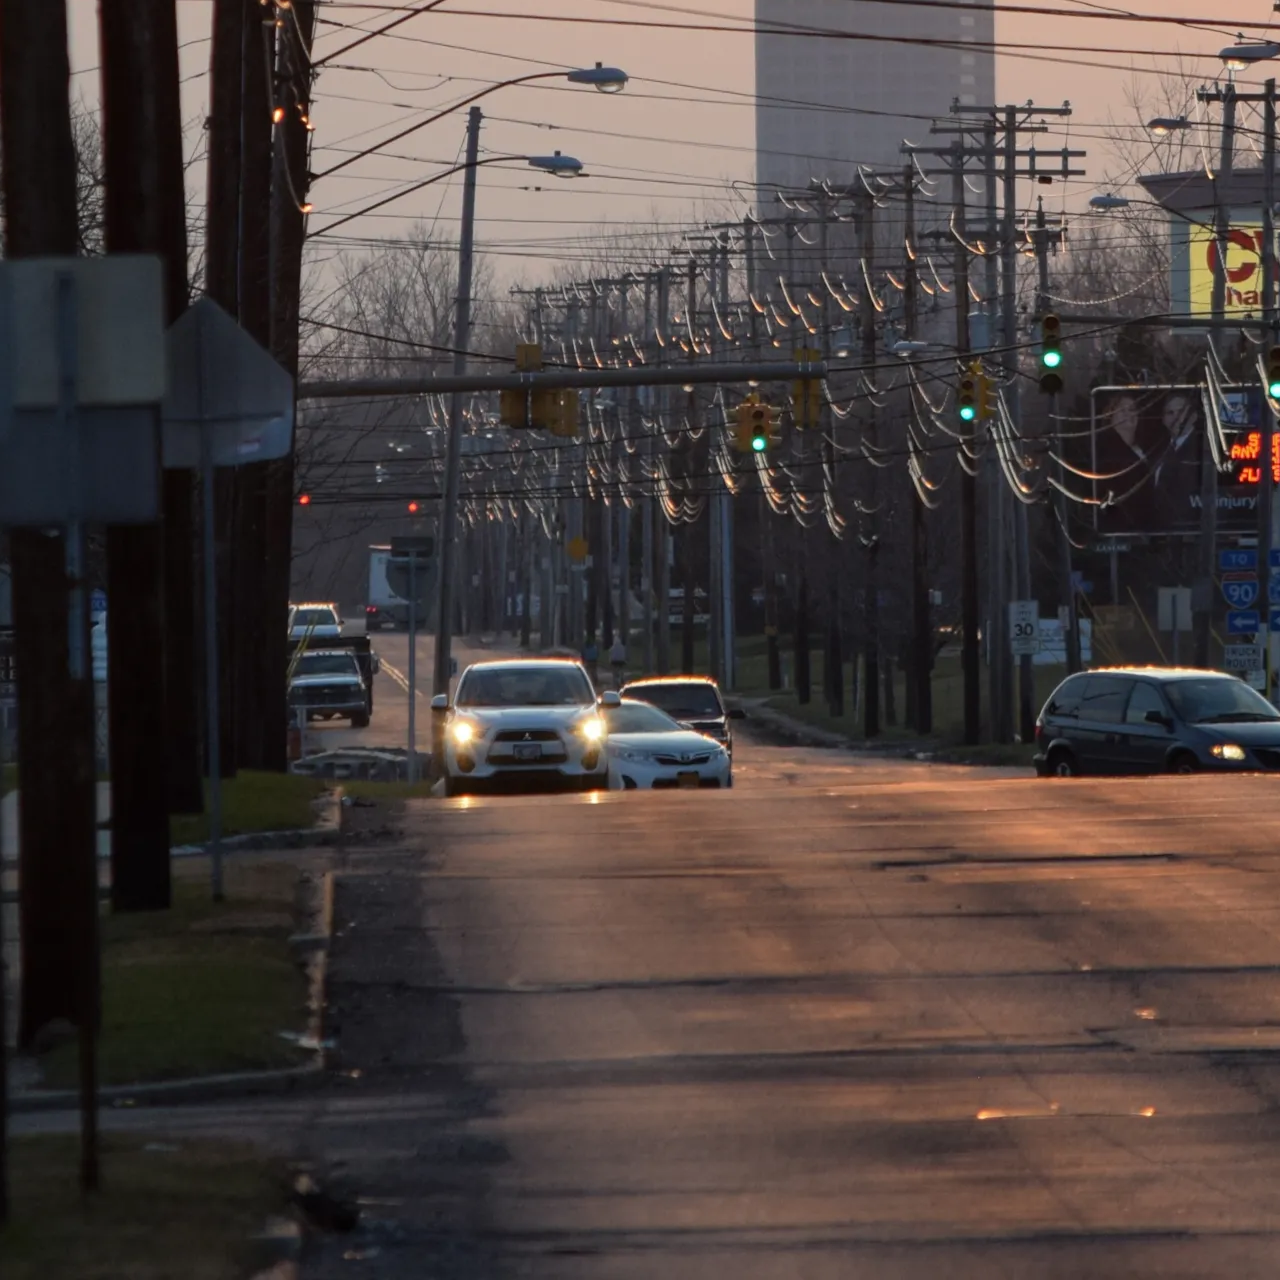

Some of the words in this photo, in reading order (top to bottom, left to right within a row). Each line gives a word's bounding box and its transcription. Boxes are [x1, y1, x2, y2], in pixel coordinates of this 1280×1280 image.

[1229, 554, 1248, 564] TO
[1229, 584, 1253, 602] 90
[1014, 623, 1034, 636] 30
[1226, 647, 1260, 657] TRUCK
[1226, 658, 1258, 668] ROUTE
